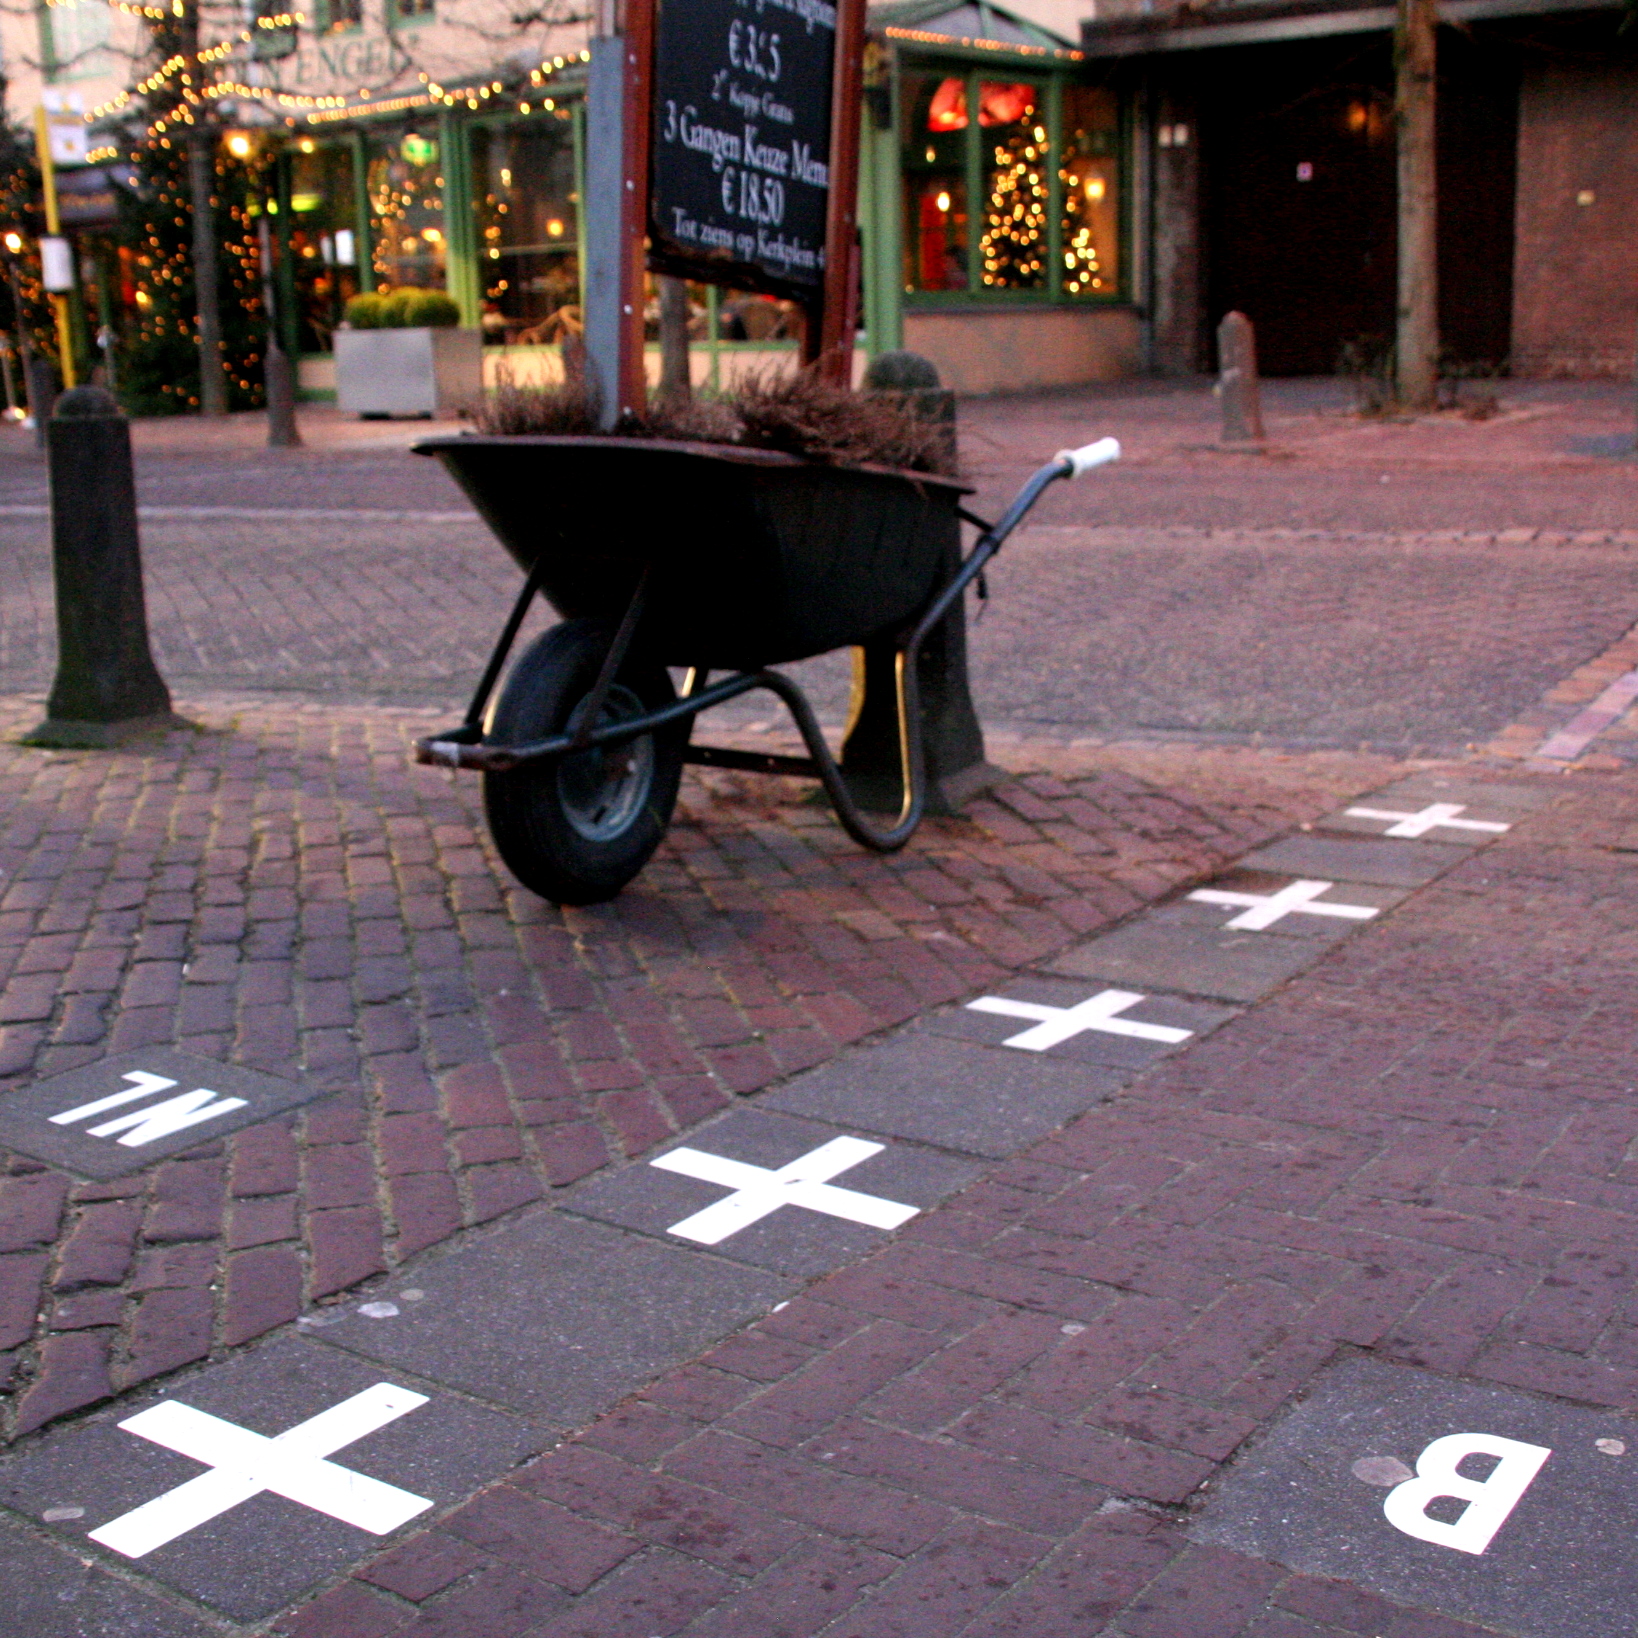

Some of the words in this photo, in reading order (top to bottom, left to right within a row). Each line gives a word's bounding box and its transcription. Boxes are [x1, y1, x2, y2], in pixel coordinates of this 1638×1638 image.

[664, 100, 678, 143] 3
[680, 105, 742, 173] Gangen
[744, 124, 789, 177] Keuze
[671, 206, 699, 240] Tot
[47, 1070, 249, 1147] NL
[1383, 1432, 1552, 1556] B
